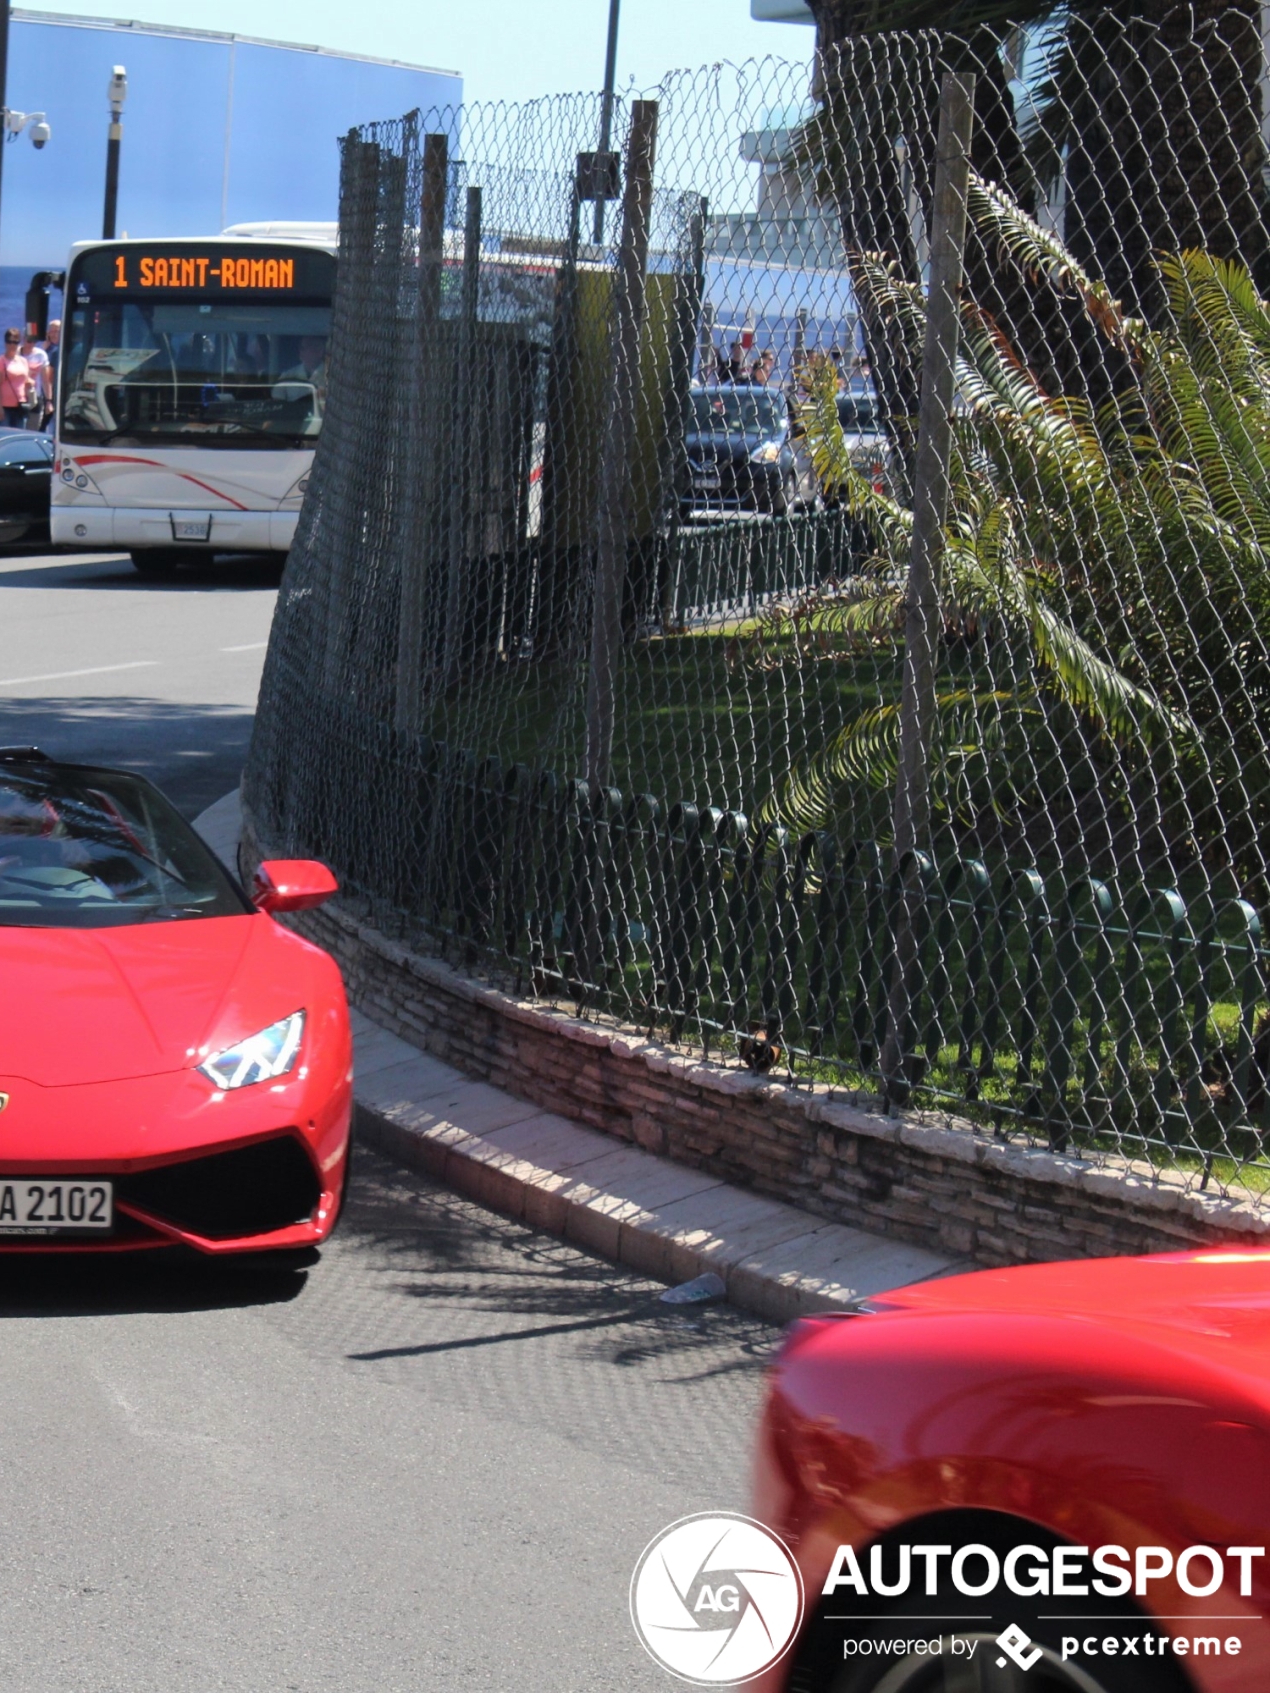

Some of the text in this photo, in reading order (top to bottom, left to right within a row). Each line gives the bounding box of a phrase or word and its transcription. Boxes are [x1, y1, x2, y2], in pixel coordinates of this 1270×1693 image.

[114, 255, 294, 289] 1 SAINT-ROMAN
[26, 1186, 107, 1223] 2102
